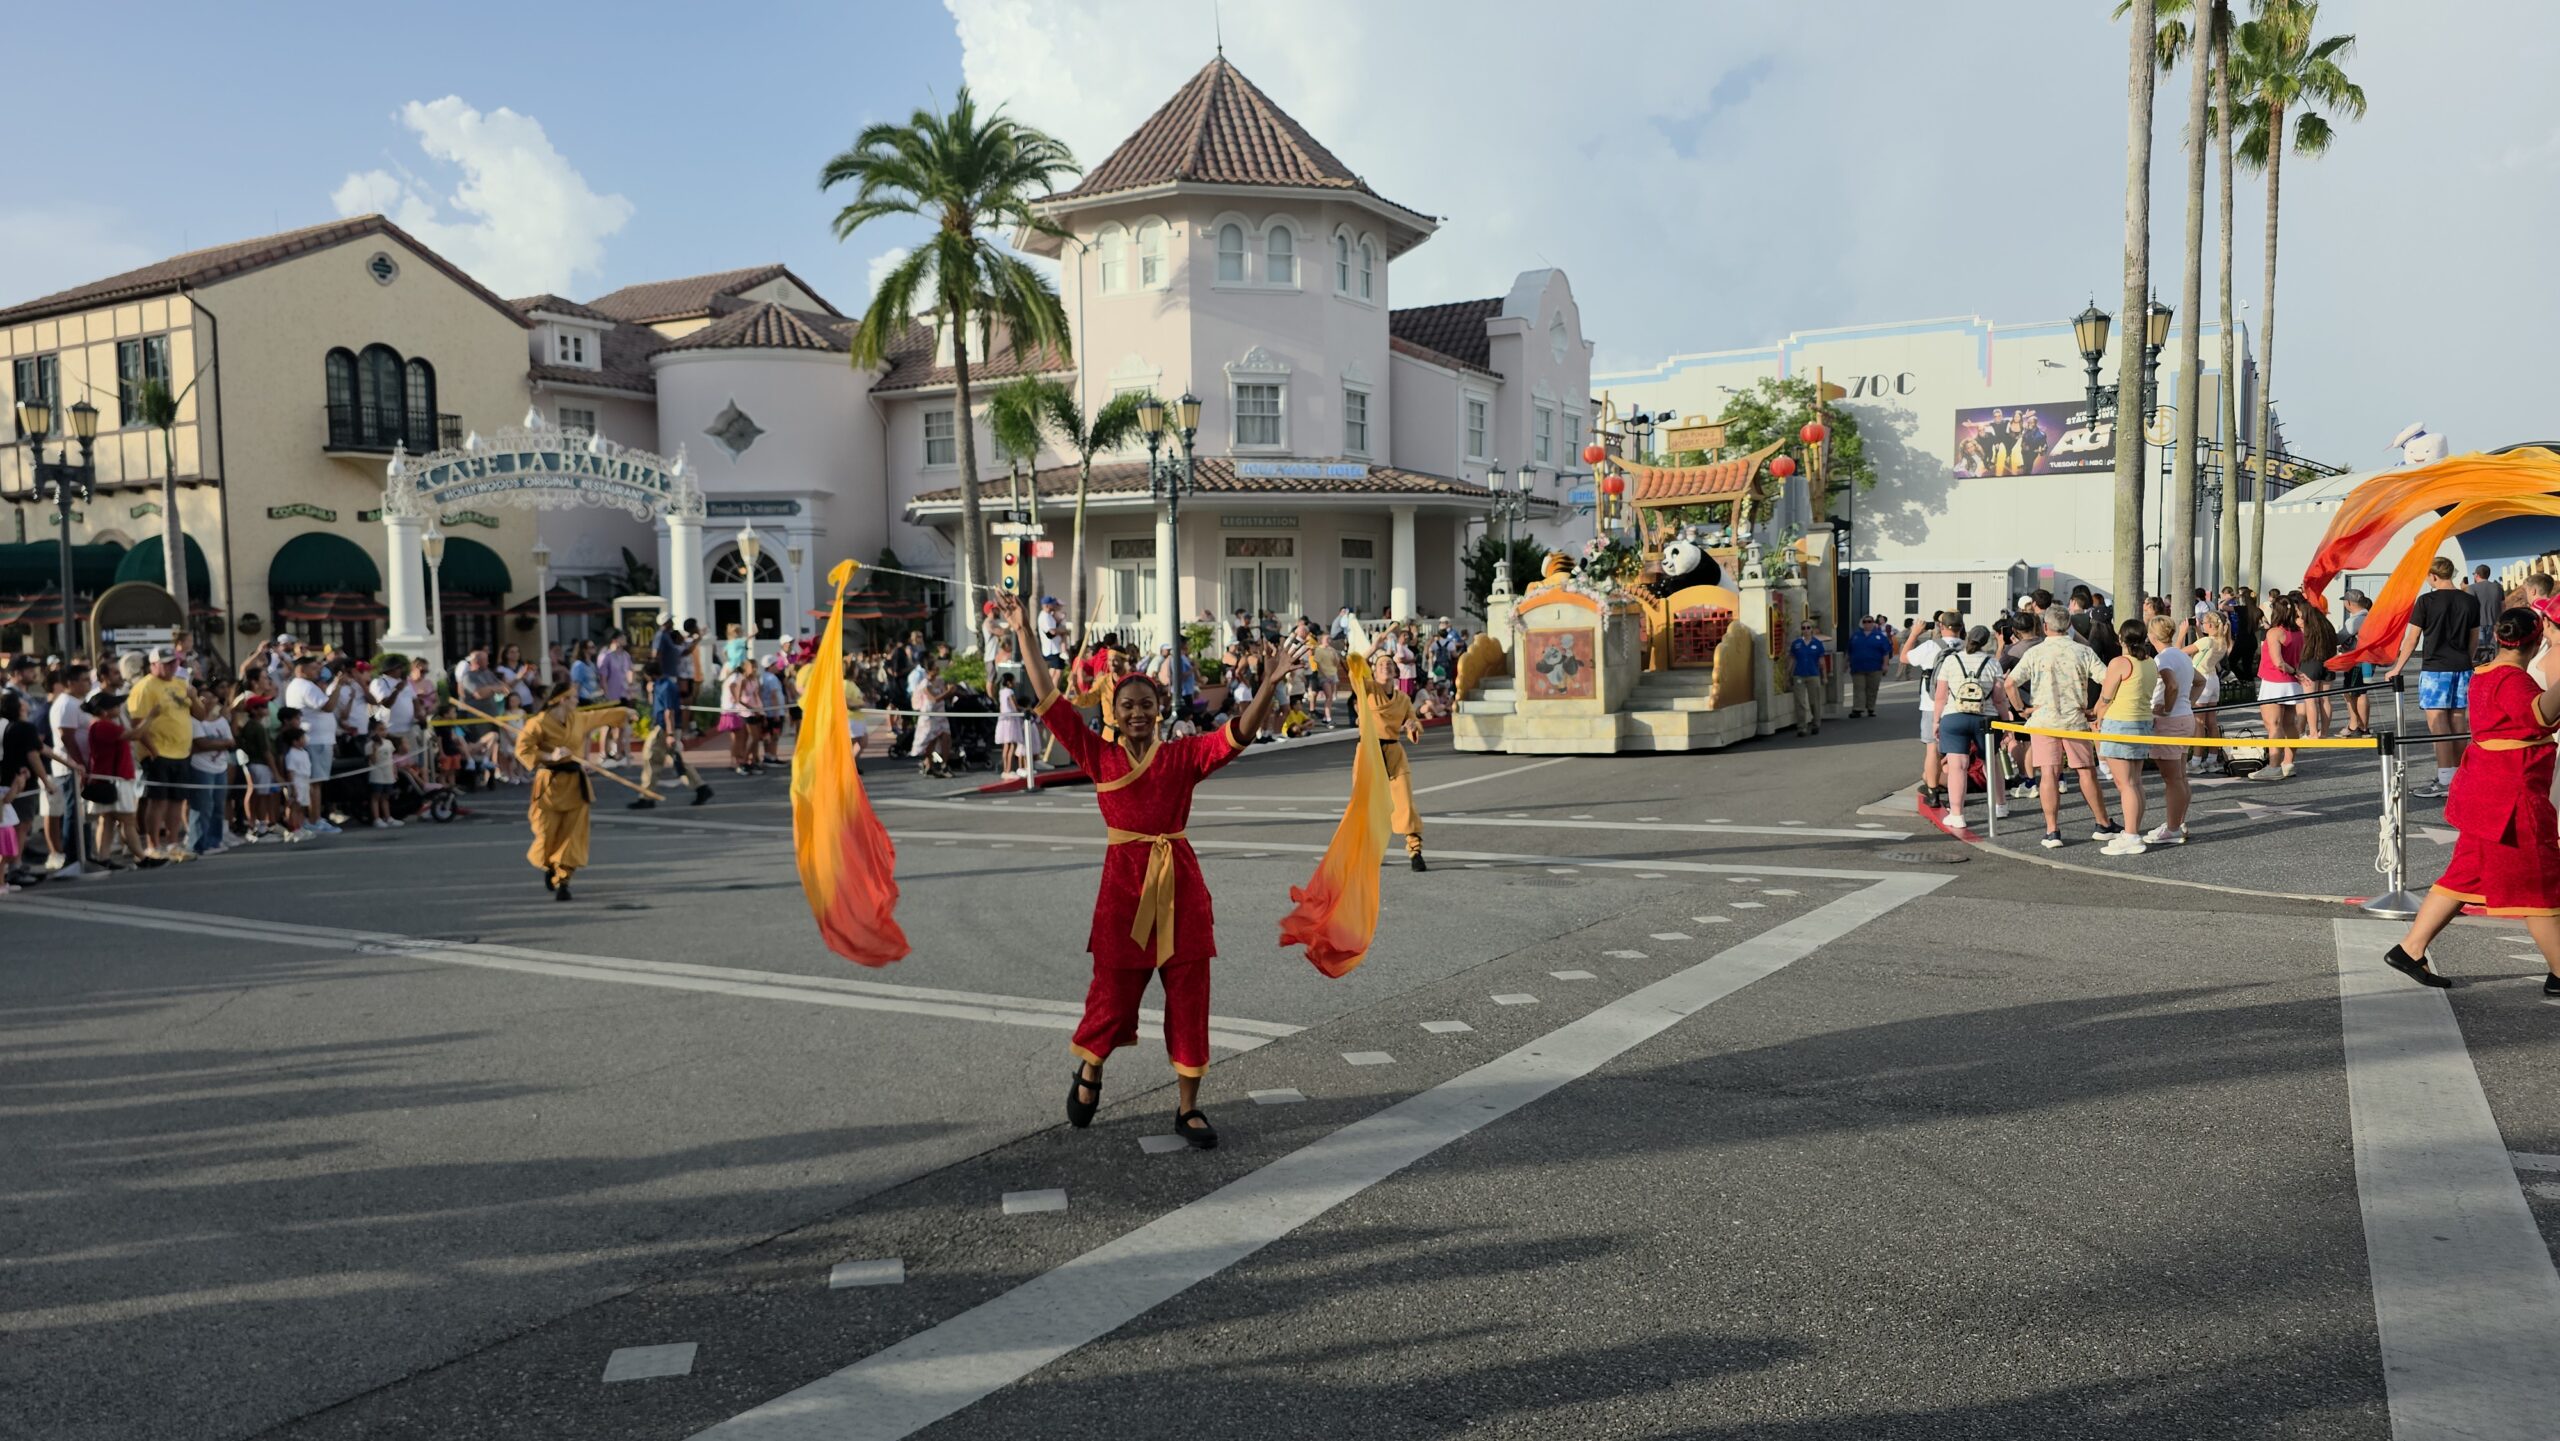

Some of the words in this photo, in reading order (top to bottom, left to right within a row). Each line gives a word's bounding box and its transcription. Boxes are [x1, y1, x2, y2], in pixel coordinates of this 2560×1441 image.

[1327, 464, 1364, 477] HOTEL
[2049, 460, 2078, 469] TUESDAY
[424, 455, 500, 489] CAFE
[514, 452, 546, 472] LA
[558, 452, 663, 491] BAMBA
[524, 477, 575, 489] ORIGINAL
[581, 479, 646, 500] RESTAURANT
[1222, 516, 1297, 526] REGISTRATION
